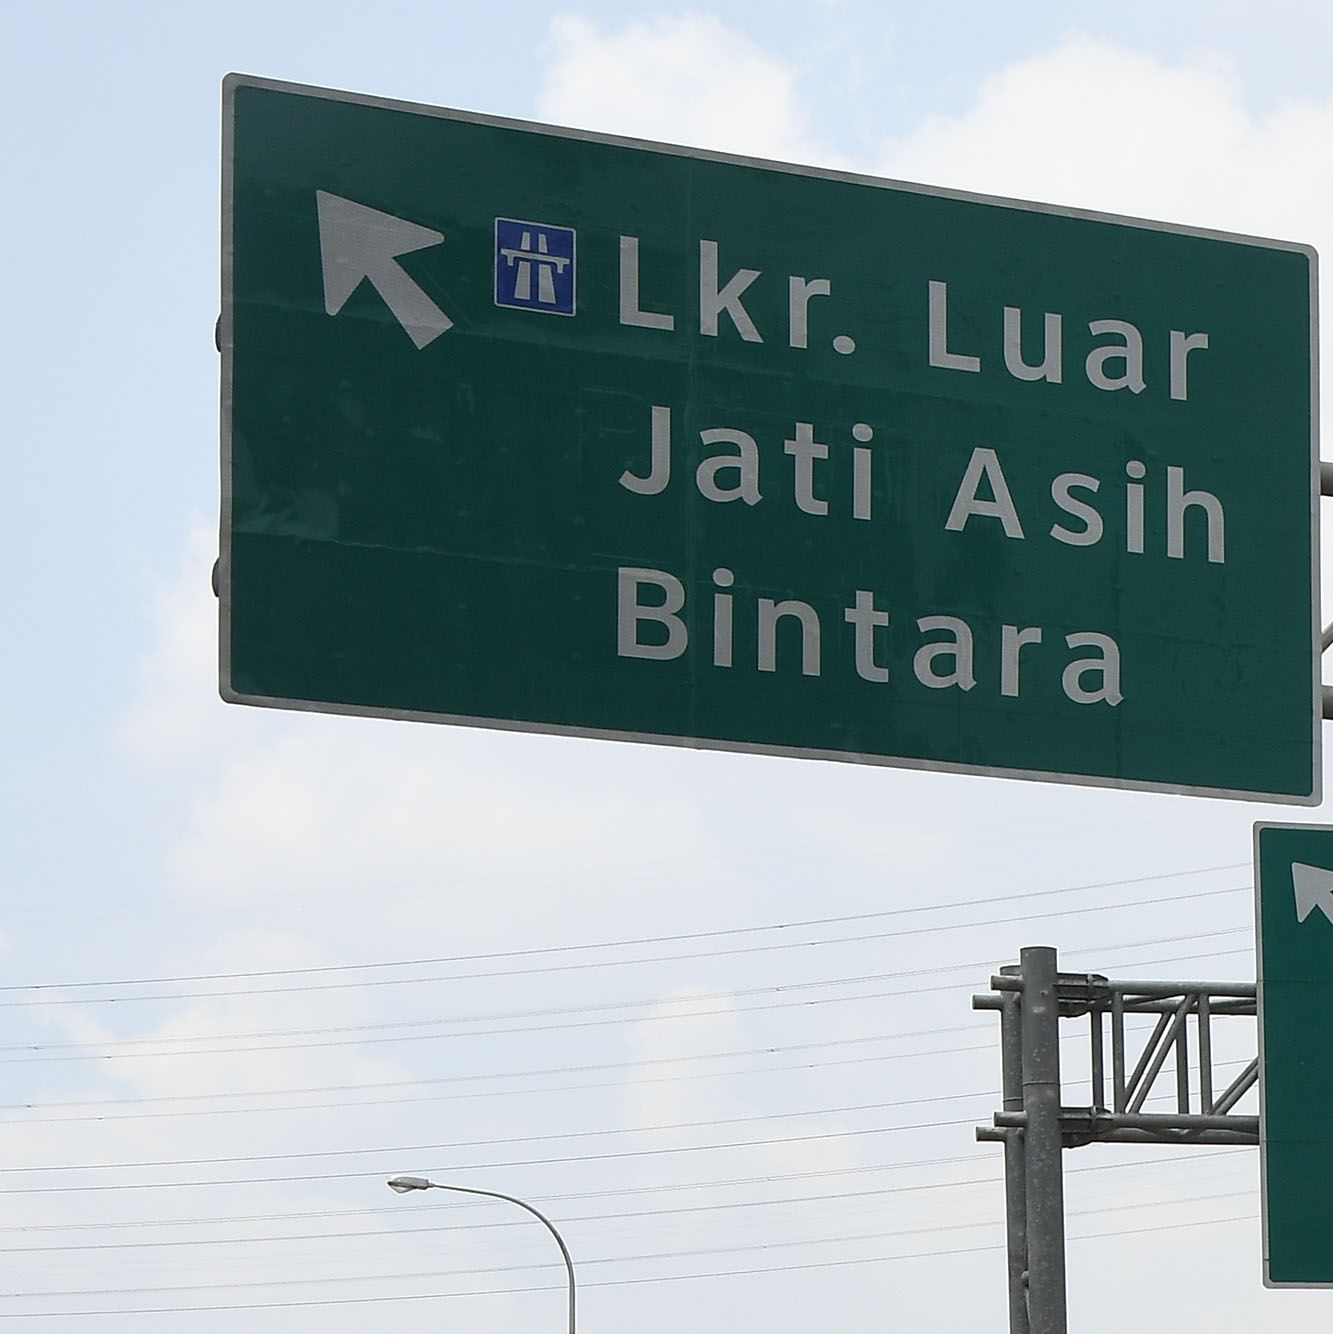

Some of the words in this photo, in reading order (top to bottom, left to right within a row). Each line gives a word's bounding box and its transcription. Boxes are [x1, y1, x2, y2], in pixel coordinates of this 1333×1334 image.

[619, 235, 856, 355] Lkr.
[928, 280, 1209, 401] Luar
[618, 405, 874, 521] Jati
[944, 447, 1225, 564] Asih
[617, 566, 1124, 707] Bintara
